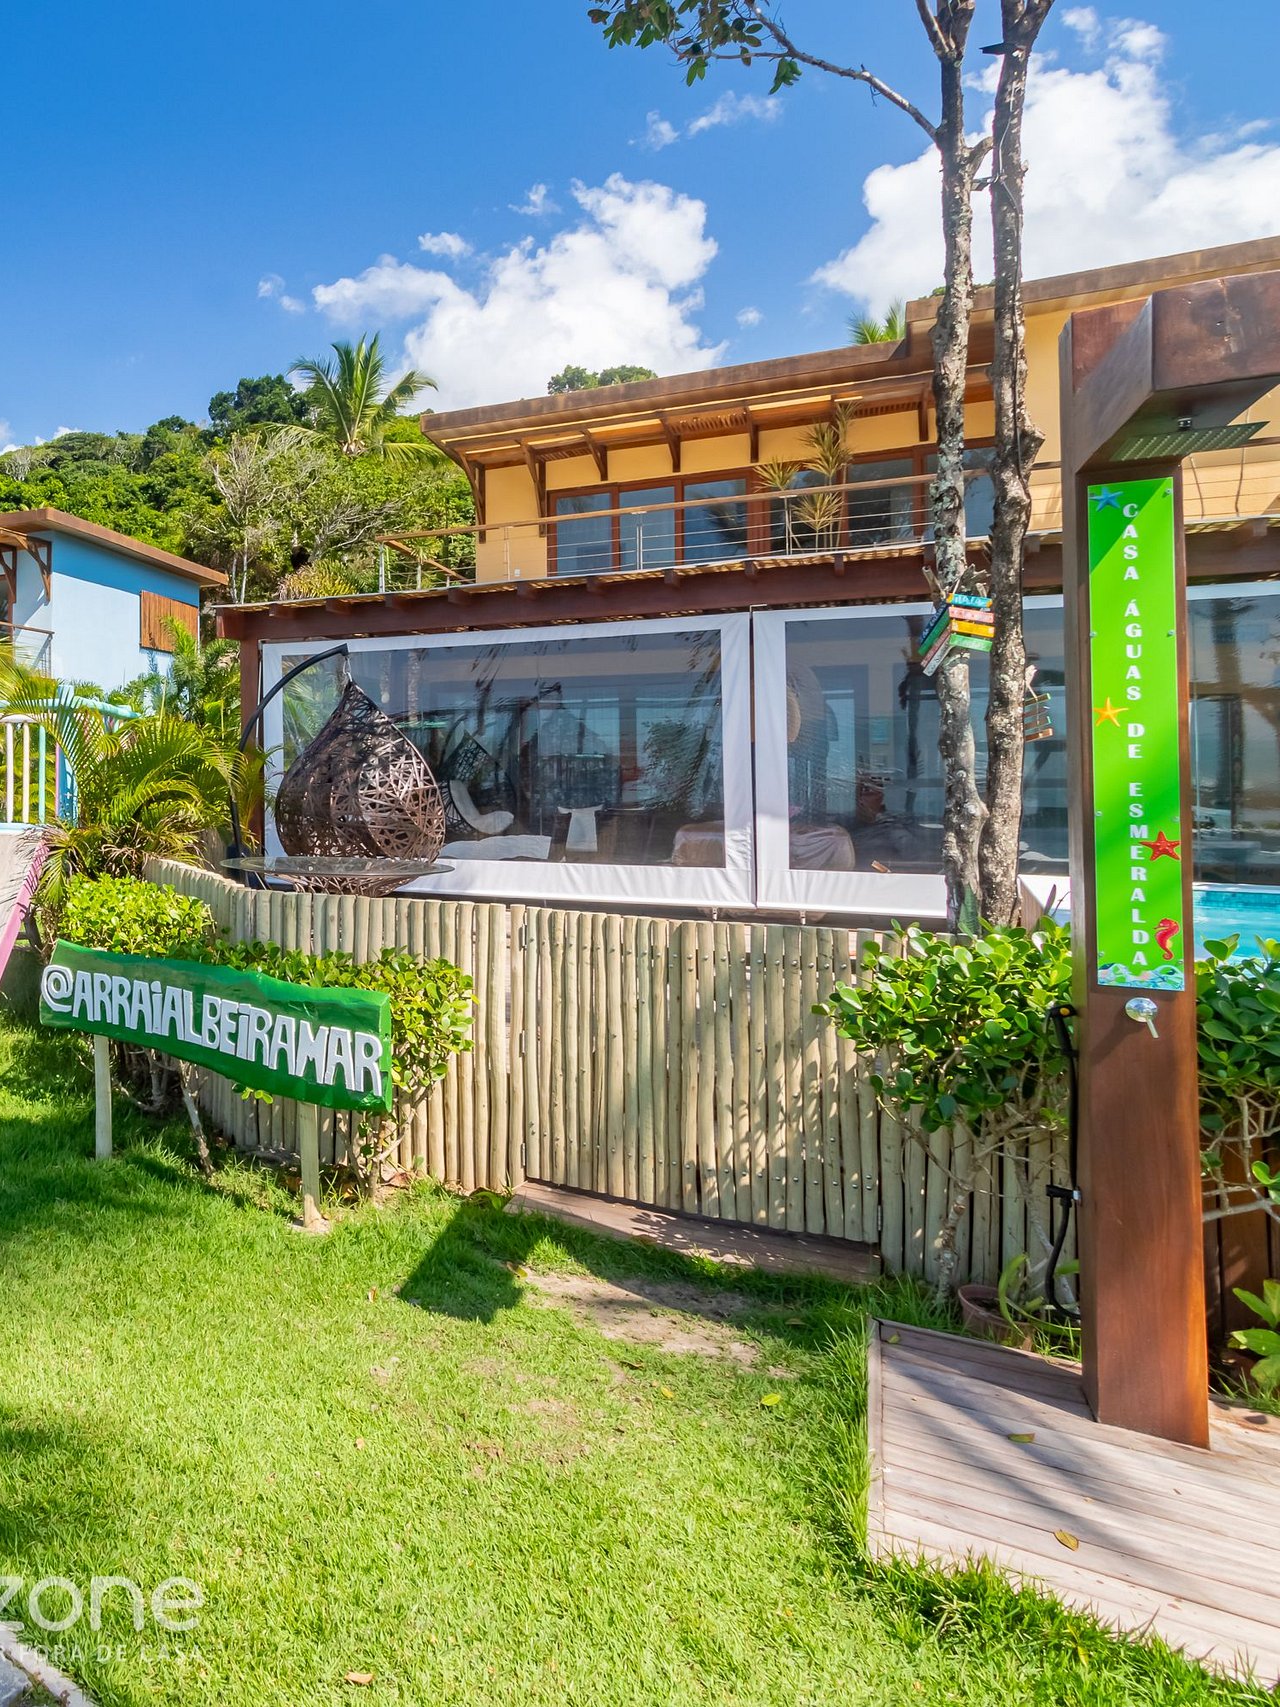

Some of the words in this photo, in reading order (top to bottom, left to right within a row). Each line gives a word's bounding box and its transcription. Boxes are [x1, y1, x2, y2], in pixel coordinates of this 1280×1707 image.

[1122, 502, 1139, 580] CASA
[1124, 598, 1142, 701] ÁGUAS
[1127, 722, 1145, 759] DE
[1128, 782, 1149, 966] ESMERALDA
